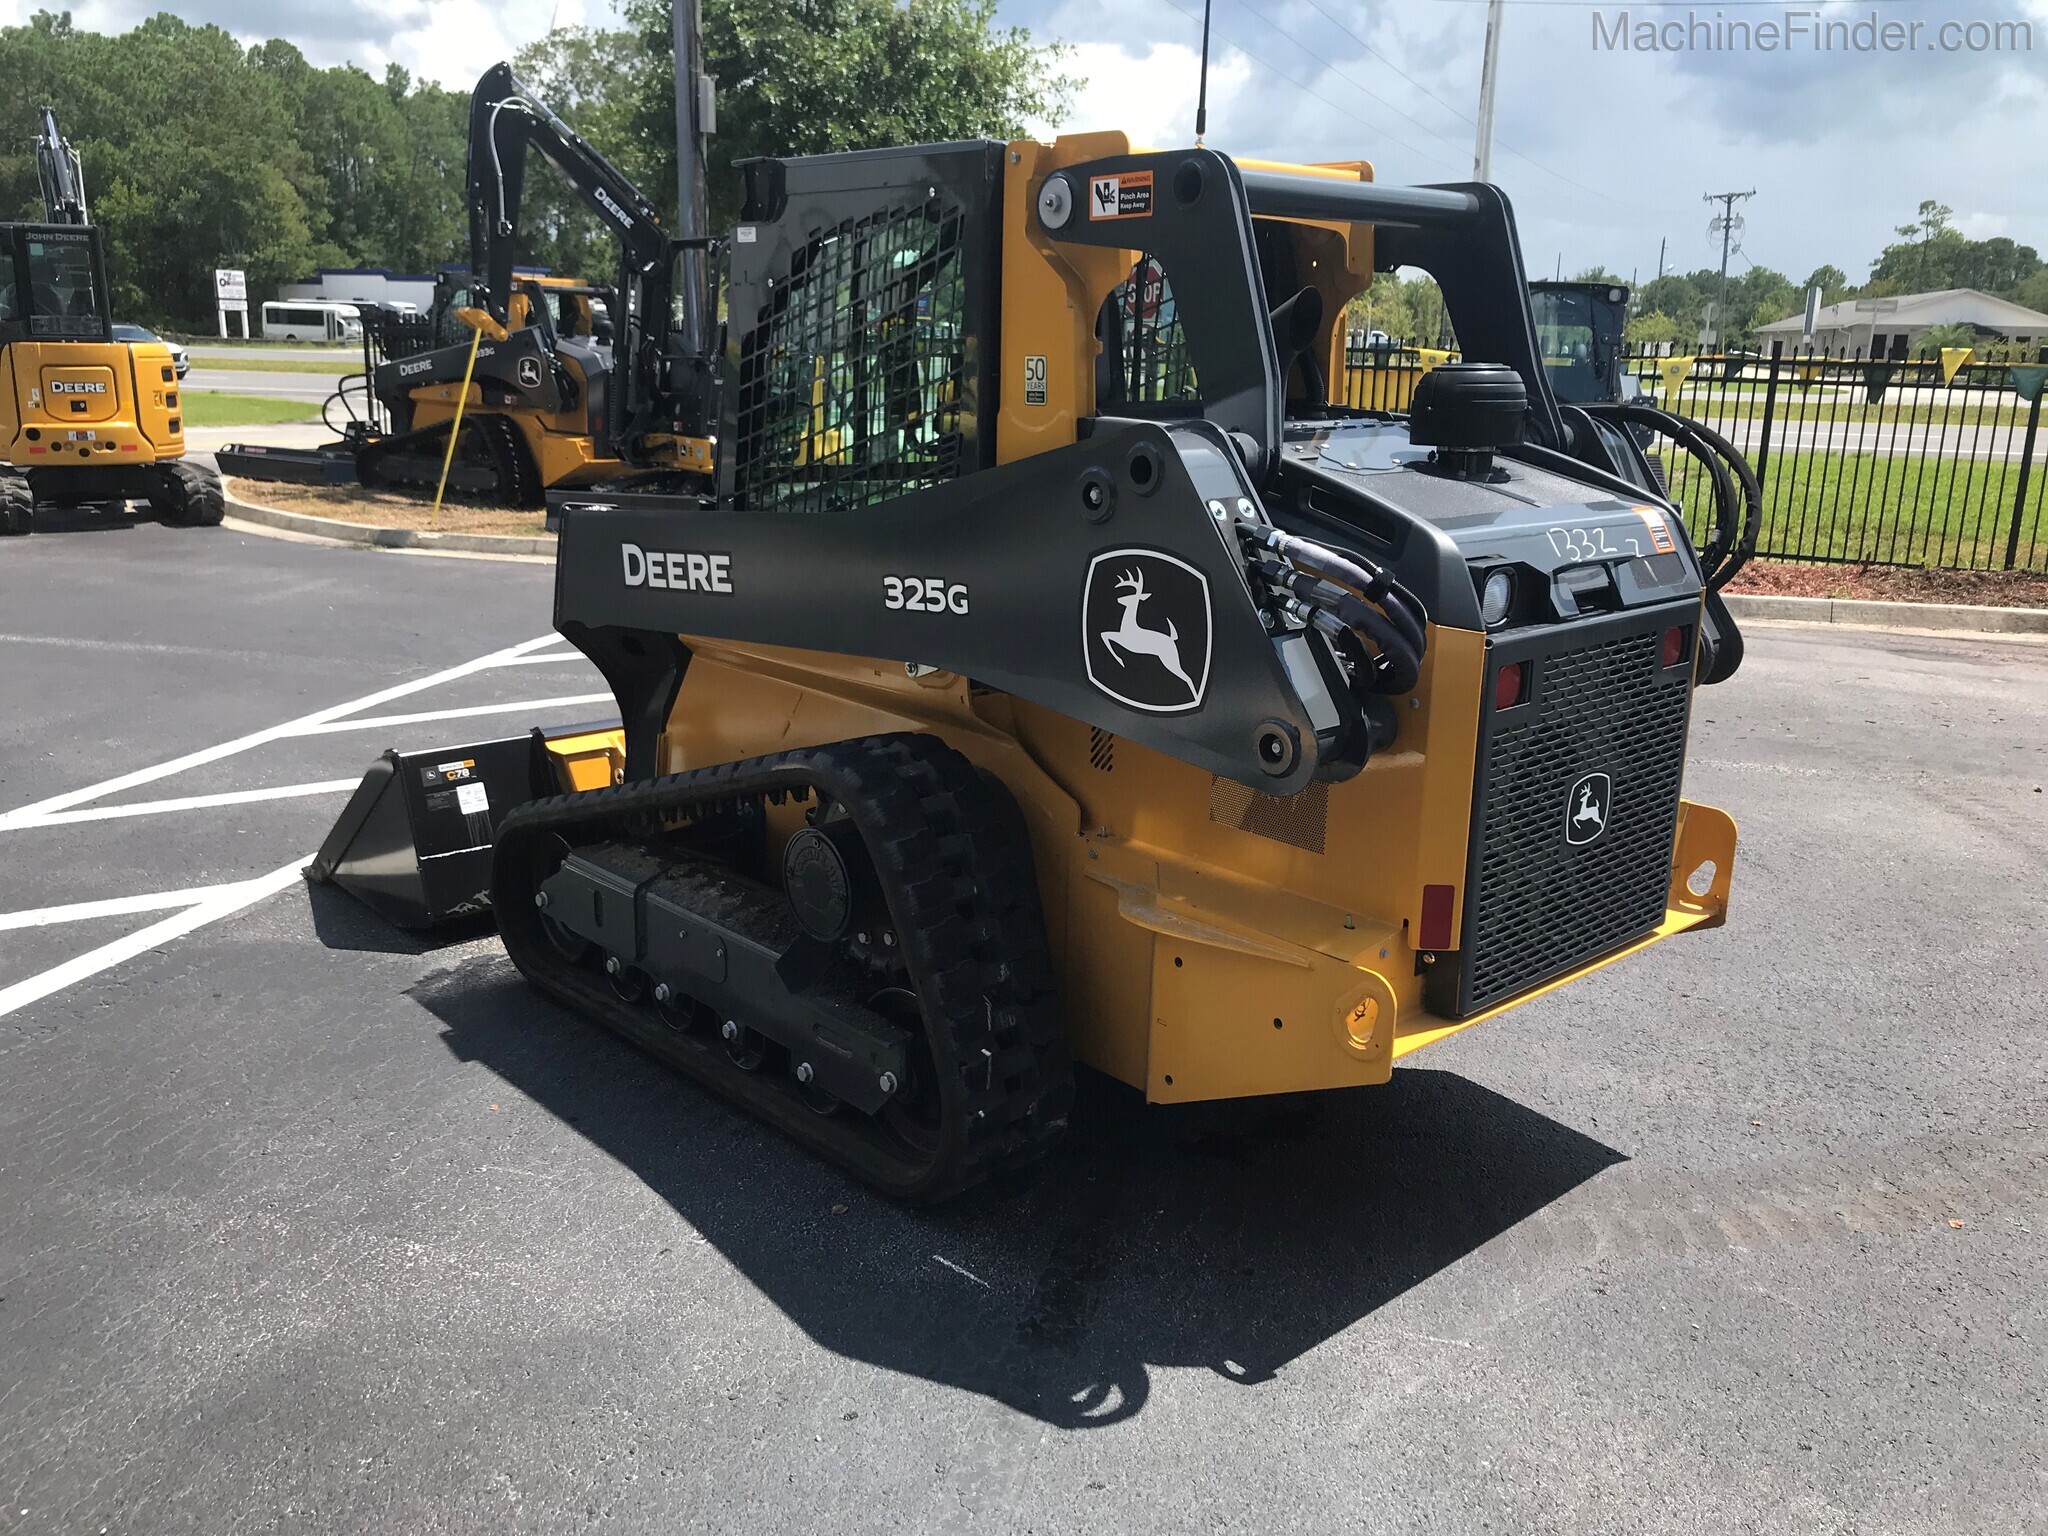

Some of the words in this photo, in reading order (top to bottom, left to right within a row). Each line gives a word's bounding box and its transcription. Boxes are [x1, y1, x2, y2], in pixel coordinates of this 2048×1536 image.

[1126, 175, 1151, 183] WARNING
[1120, 192, 1136, 201] Pinch
[1136, 191, 1150, 199] Area
[594, 186, 635, 230] DEERE
[25, 232, 53, 240] JOHN
[55, 233, 89, 241] DEERE
[1127, 282, 1160, 303] SOP
[400, 360, 433, 377] DEERE
[1026, 358, 1045, 381] 50
[51, 381, 106, 393] DEERE
[1027, 382, 1045, 390] YEARS
[621, 543, 733, 593] DEERE
[883, 576, 969, 615] 325G
